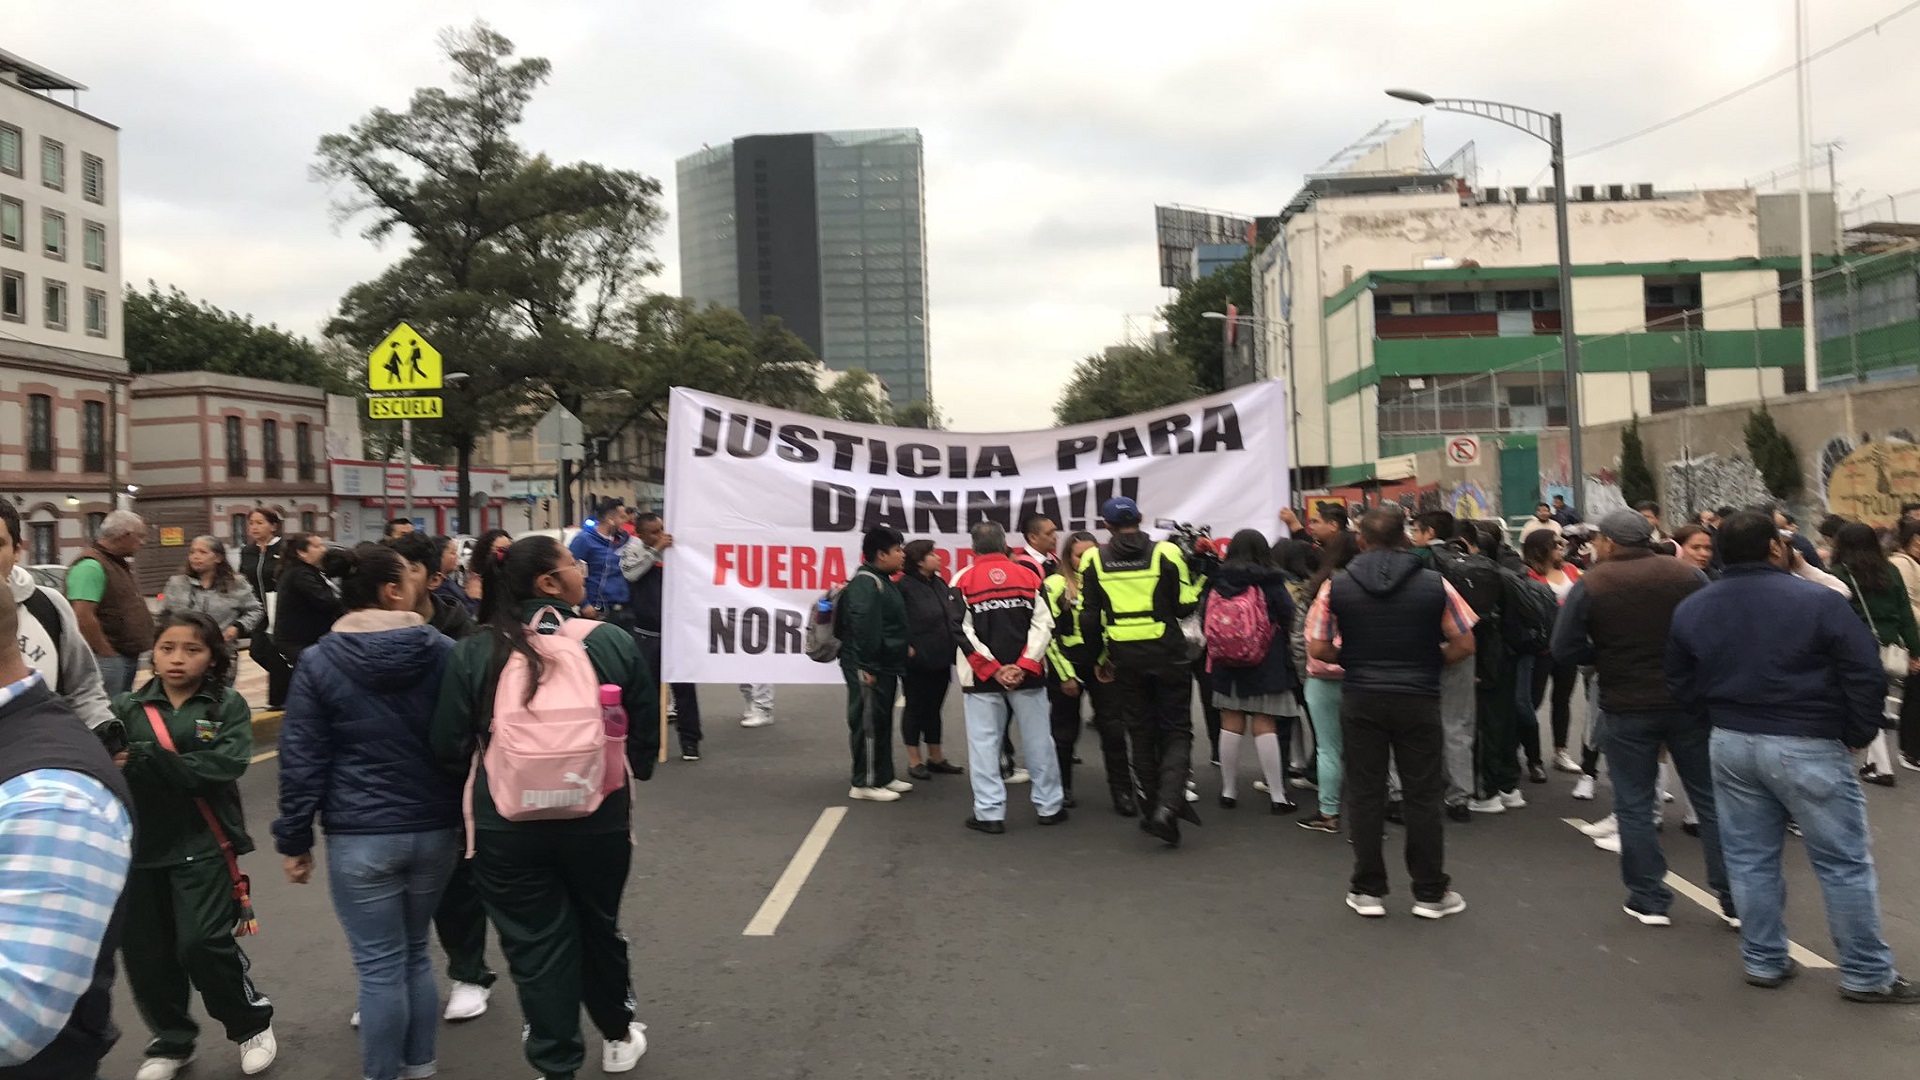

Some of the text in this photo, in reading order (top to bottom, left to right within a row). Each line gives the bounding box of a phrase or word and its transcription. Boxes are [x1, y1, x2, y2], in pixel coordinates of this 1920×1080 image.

[373, 400, 438, 415] ESCUELA
[693, 403, 1246, 479] JUSTICIA PARA
[713, 543, 849, 590] FUERA
[709, 606, 803, 655] NOR
[522, 788, 586, 809] PUMA
